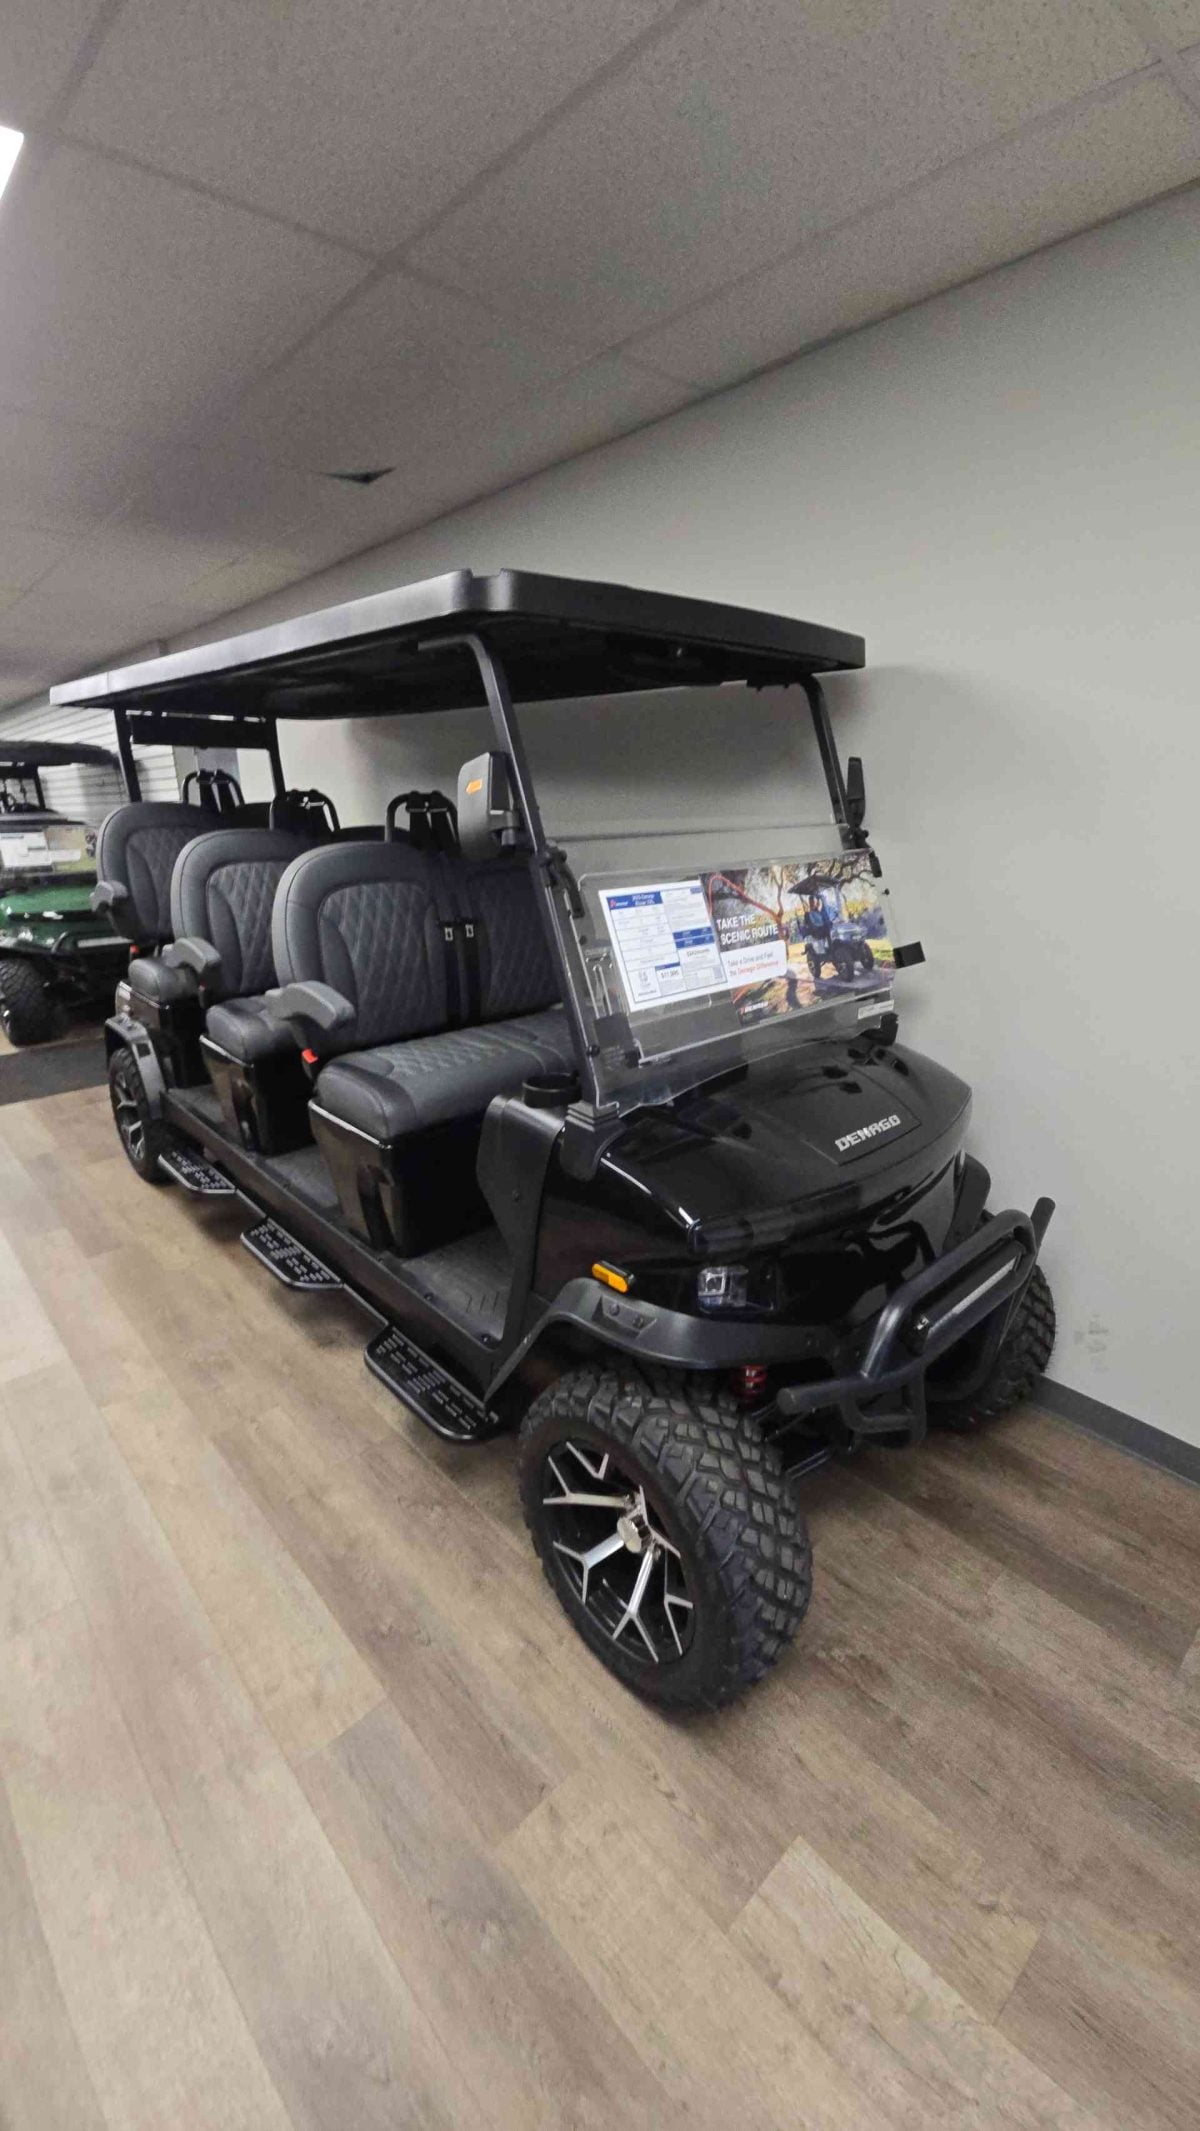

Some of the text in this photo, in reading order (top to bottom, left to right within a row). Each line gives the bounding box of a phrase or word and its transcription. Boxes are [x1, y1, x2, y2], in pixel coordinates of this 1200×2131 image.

[716, 913, 756, 931] TAKE THE
[720, 929, 751, 945] SCENIC
[752, 923, 779, 939] ROUTE
[834, 1114, 901, 1152] DENAGO
